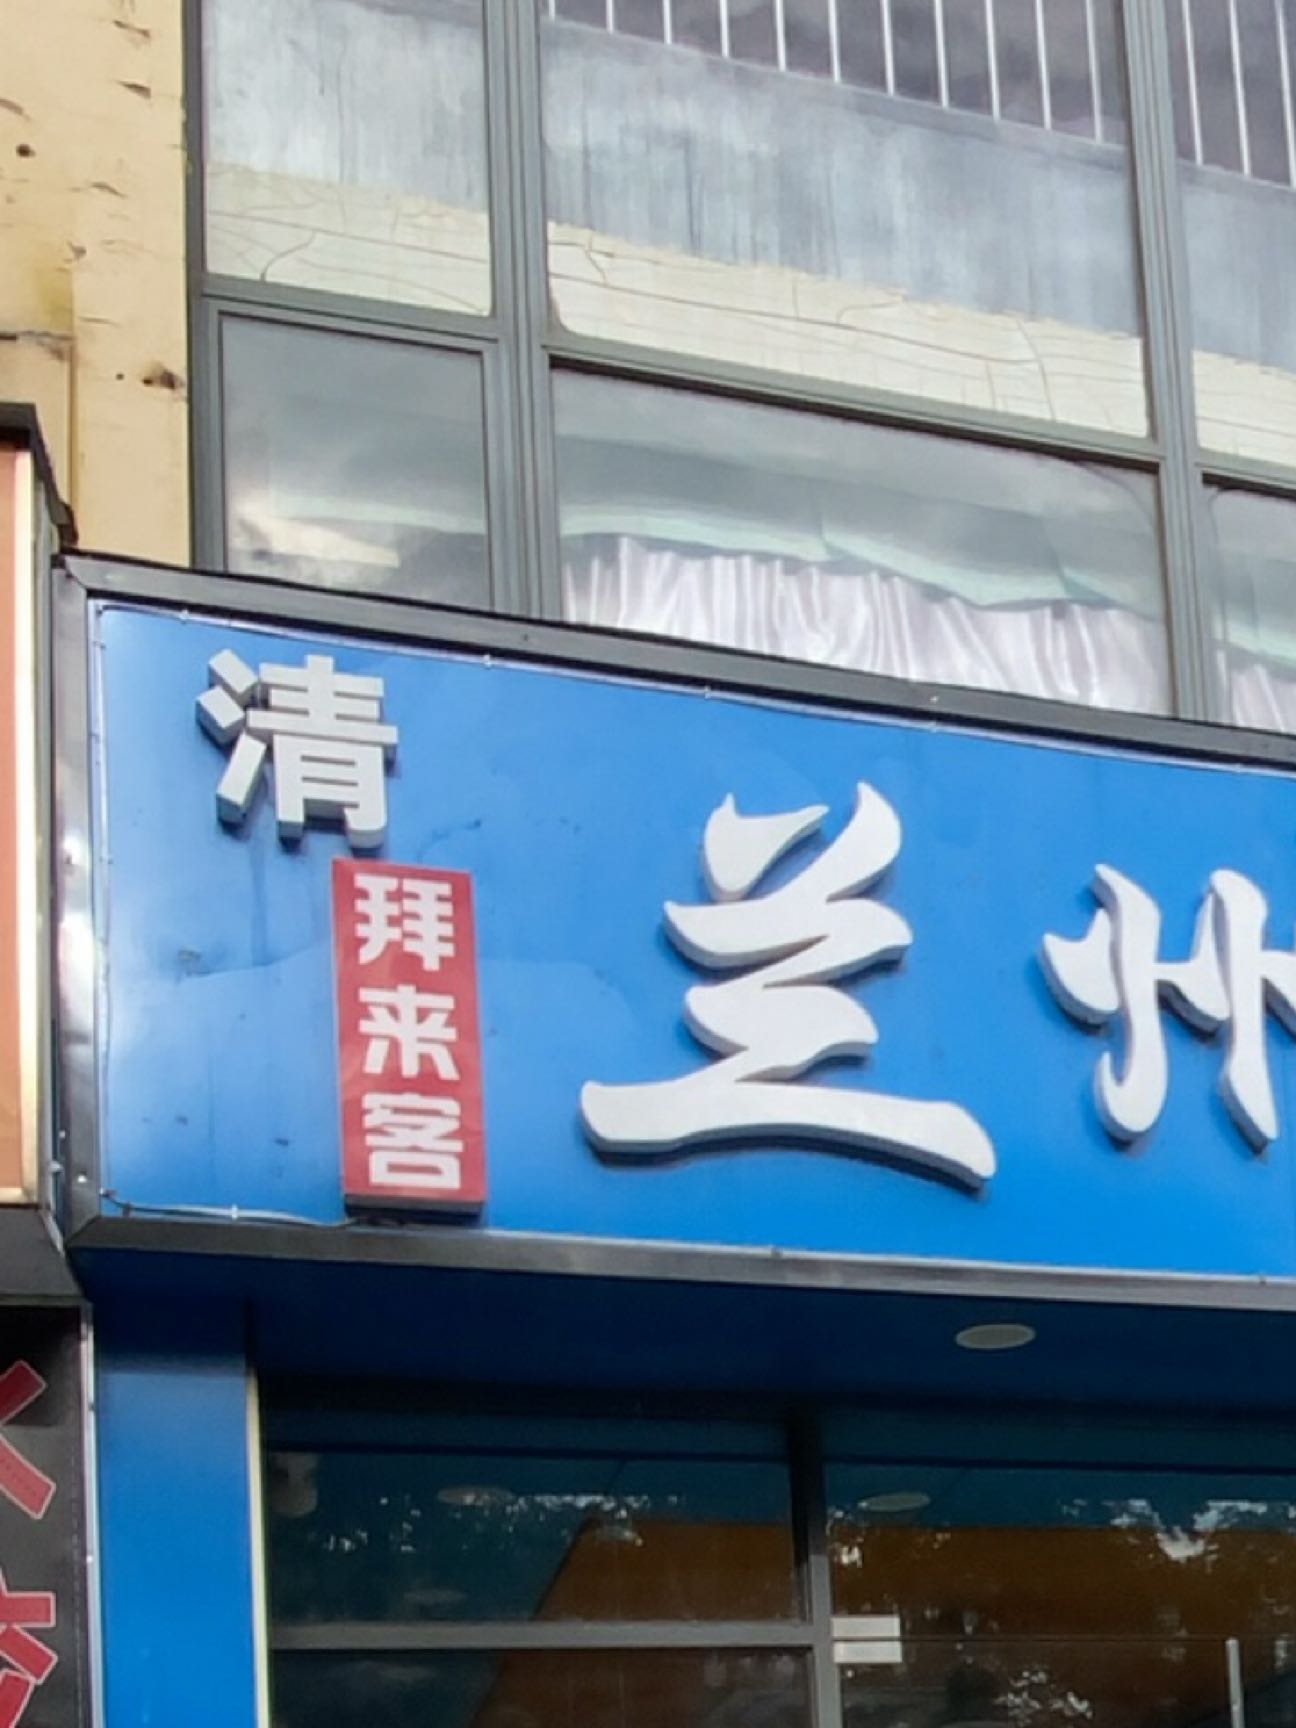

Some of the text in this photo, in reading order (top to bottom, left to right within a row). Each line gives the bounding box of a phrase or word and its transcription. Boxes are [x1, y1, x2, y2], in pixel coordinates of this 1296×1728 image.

[194, 648, 399, 850] 清
[352, 872, 465, 1191] 拜来客
